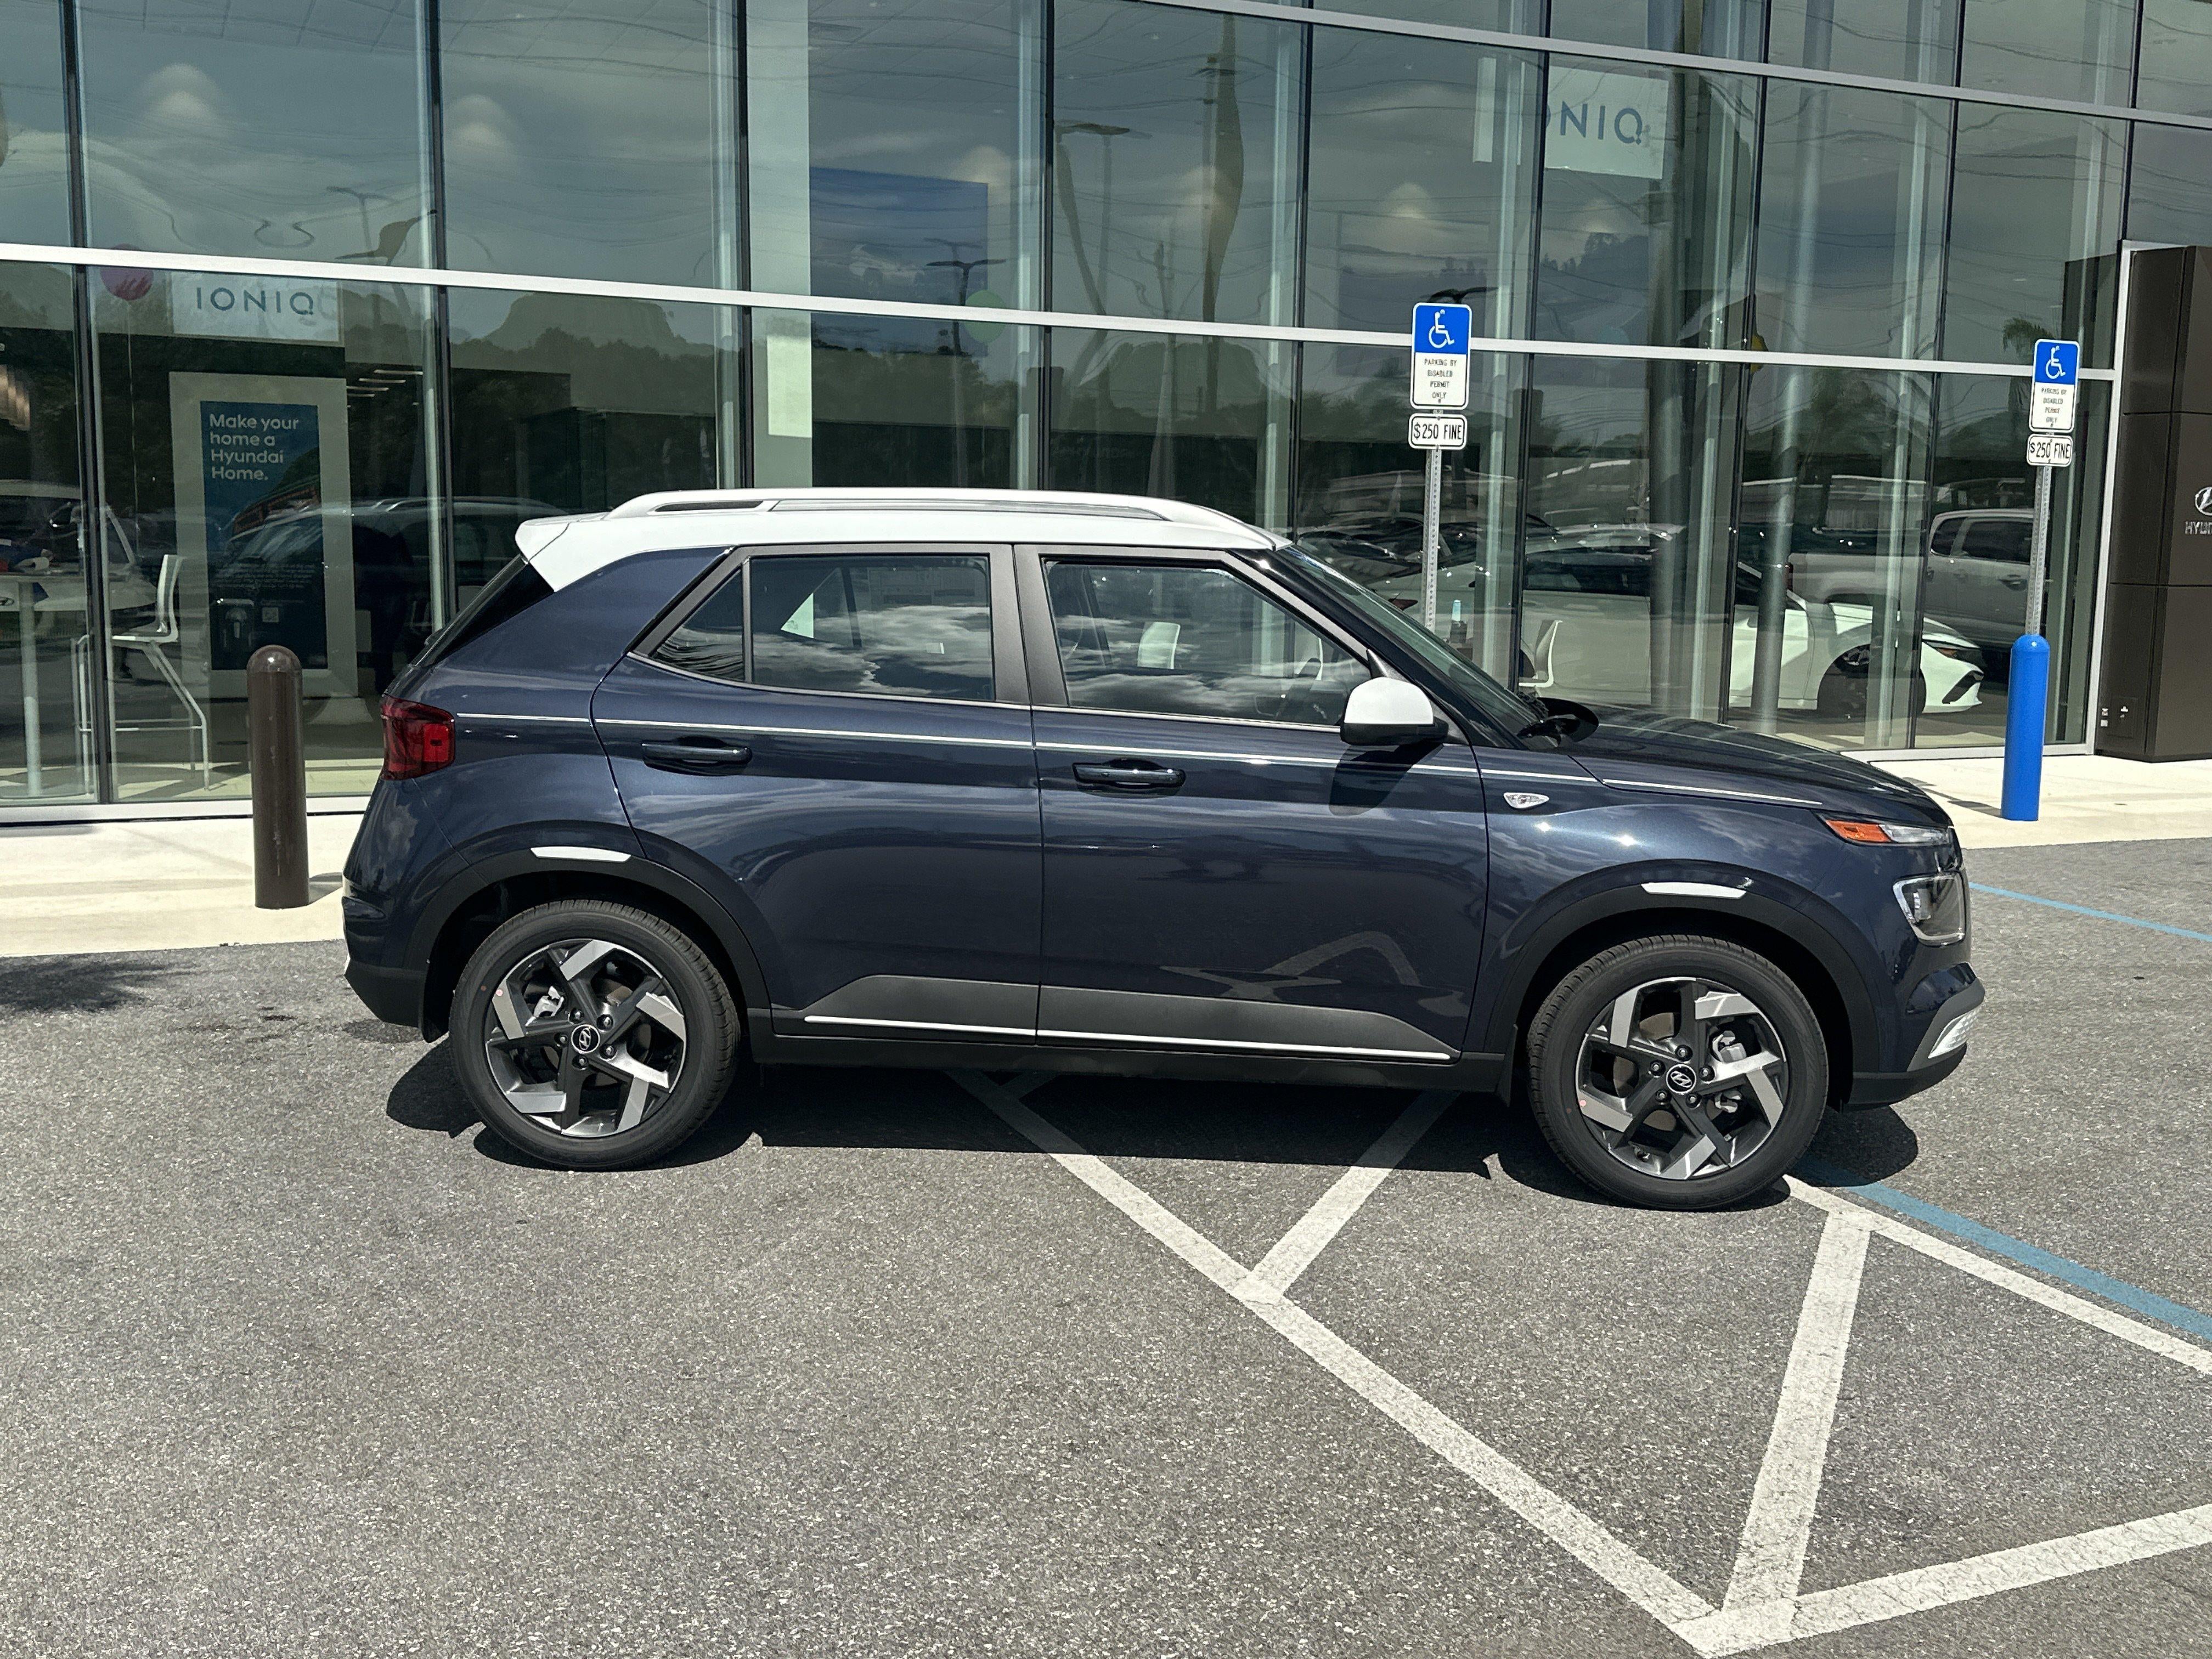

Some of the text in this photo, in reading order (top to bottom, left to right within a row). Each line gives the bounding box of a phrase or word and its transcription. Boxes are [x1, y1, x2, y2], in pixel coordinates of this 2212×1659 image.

[1546, 101, 1643, 145] NIQ
[196, 287, 314, 315] IONIQ
[210, 414, 299, 432] Make your
[1413, 422, 1462, 441] $250 FINE
[210, 431, 275, 446] home a
[211, 448, 284, 465] Hyundai
[2053, 443, 2072, 459] FINE
[212, 466, 269, 481] Home.
